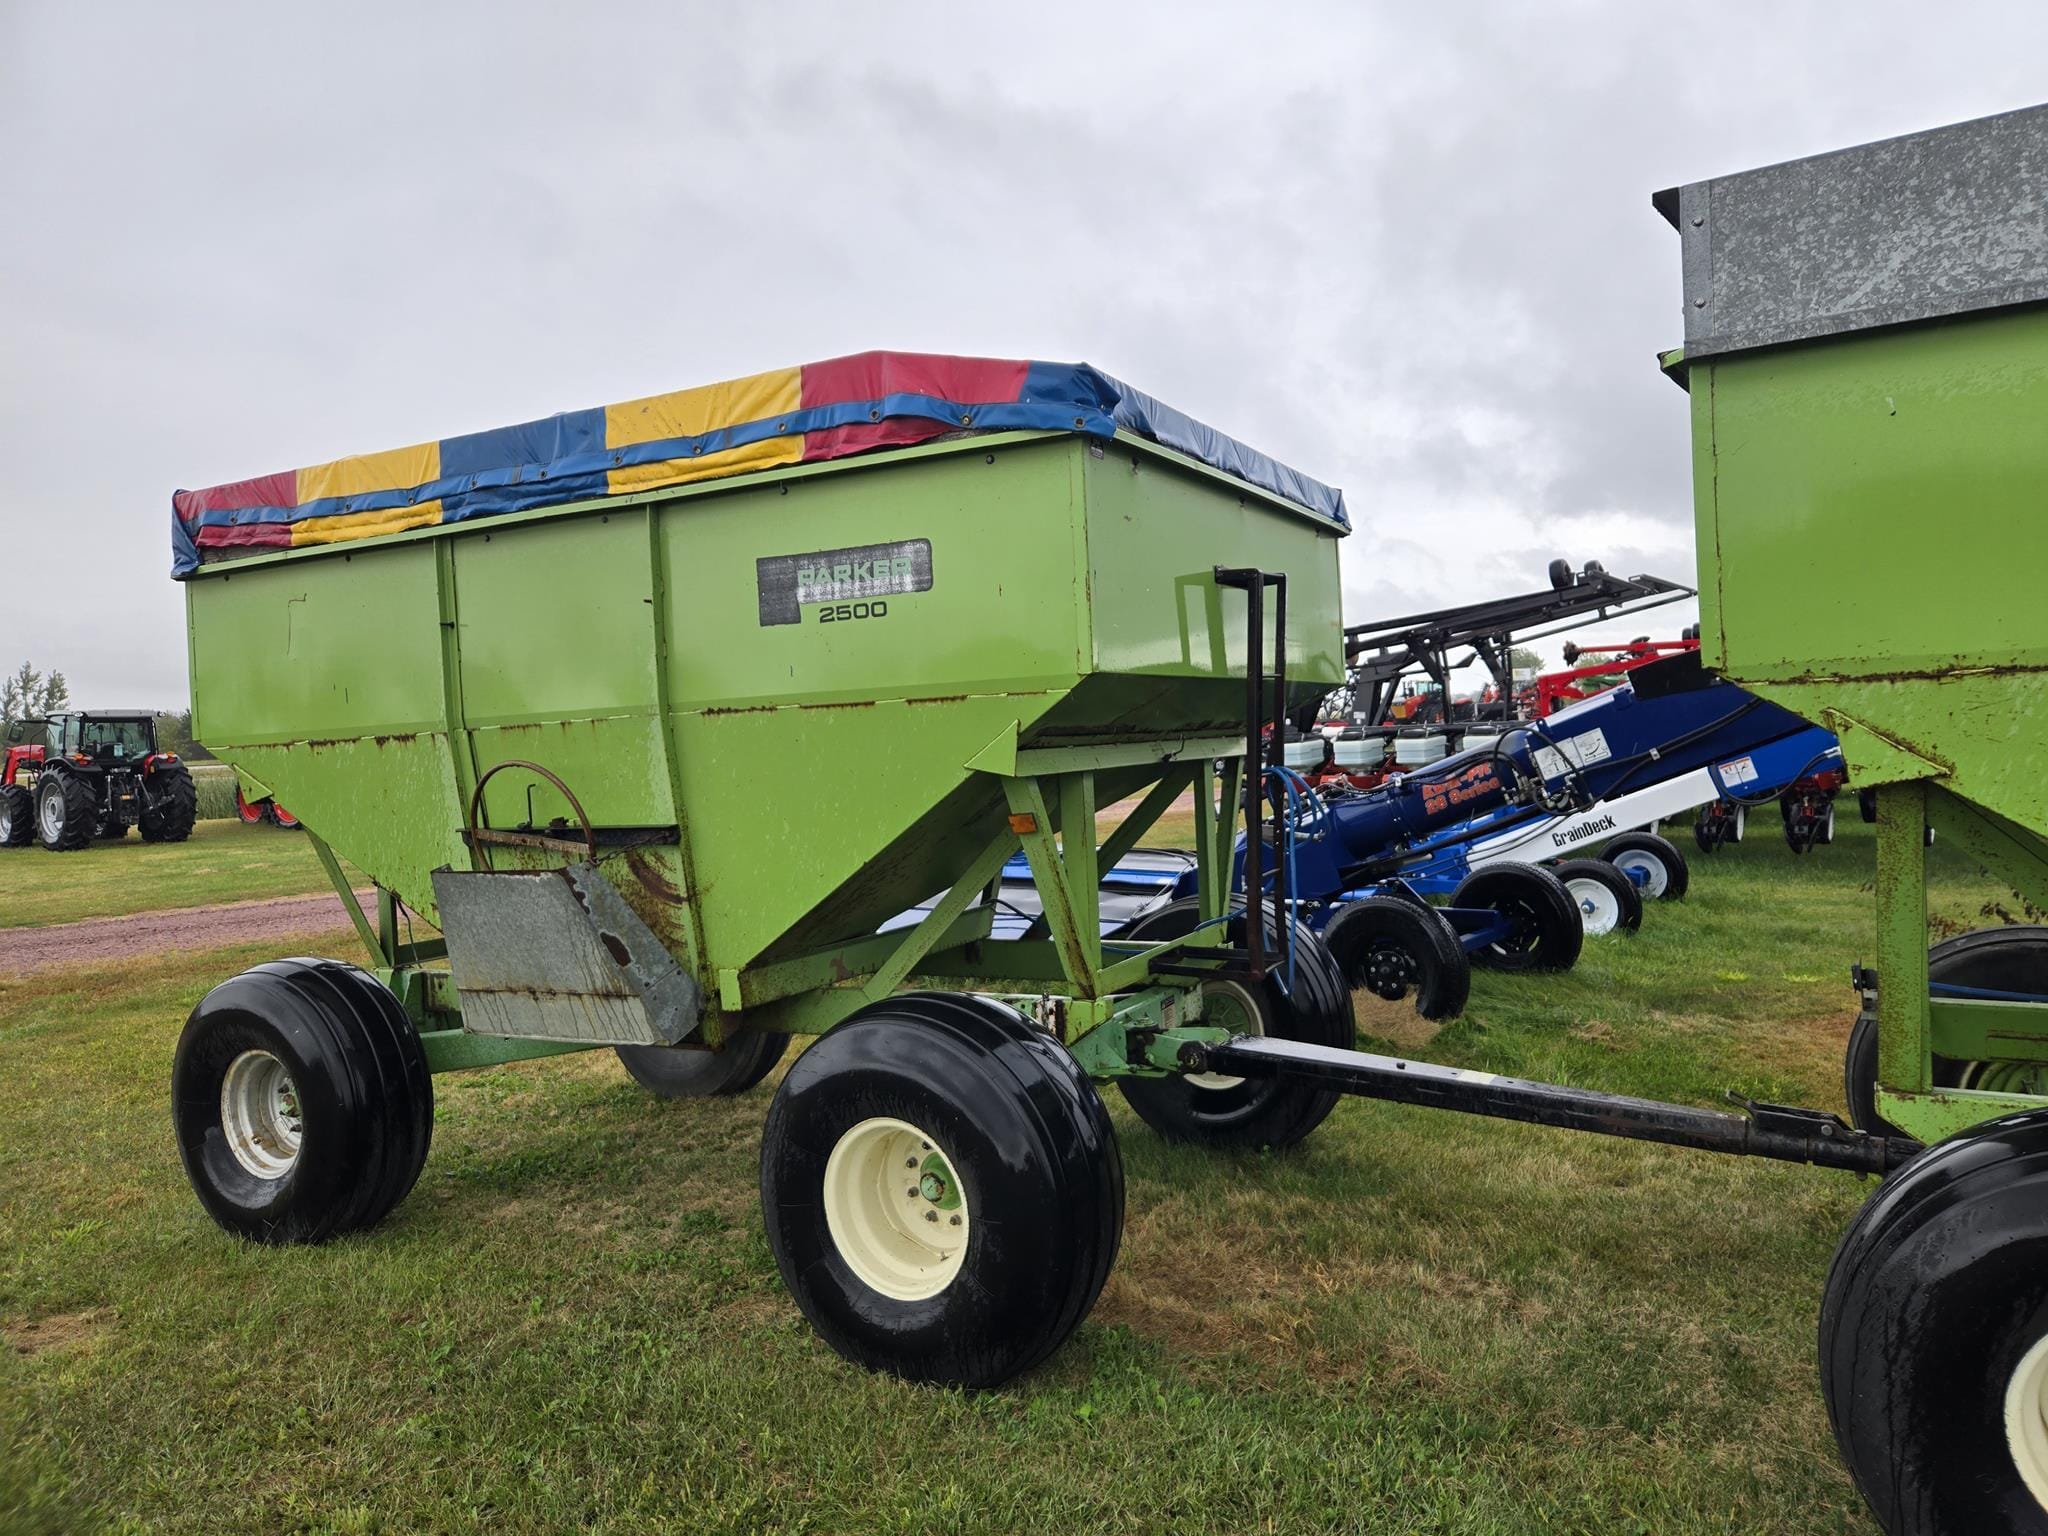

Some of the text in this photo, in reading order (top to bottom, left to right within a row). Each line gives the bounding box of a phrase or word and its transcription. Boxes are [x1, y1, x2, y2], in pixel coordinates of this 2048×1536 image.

[798, 556, 912, 588] PARKER
[819, 600, 888, 624] 2500
[1448, 777, 1500, 805] Series
[1551, 814, 1617, 847] GrainDeck
